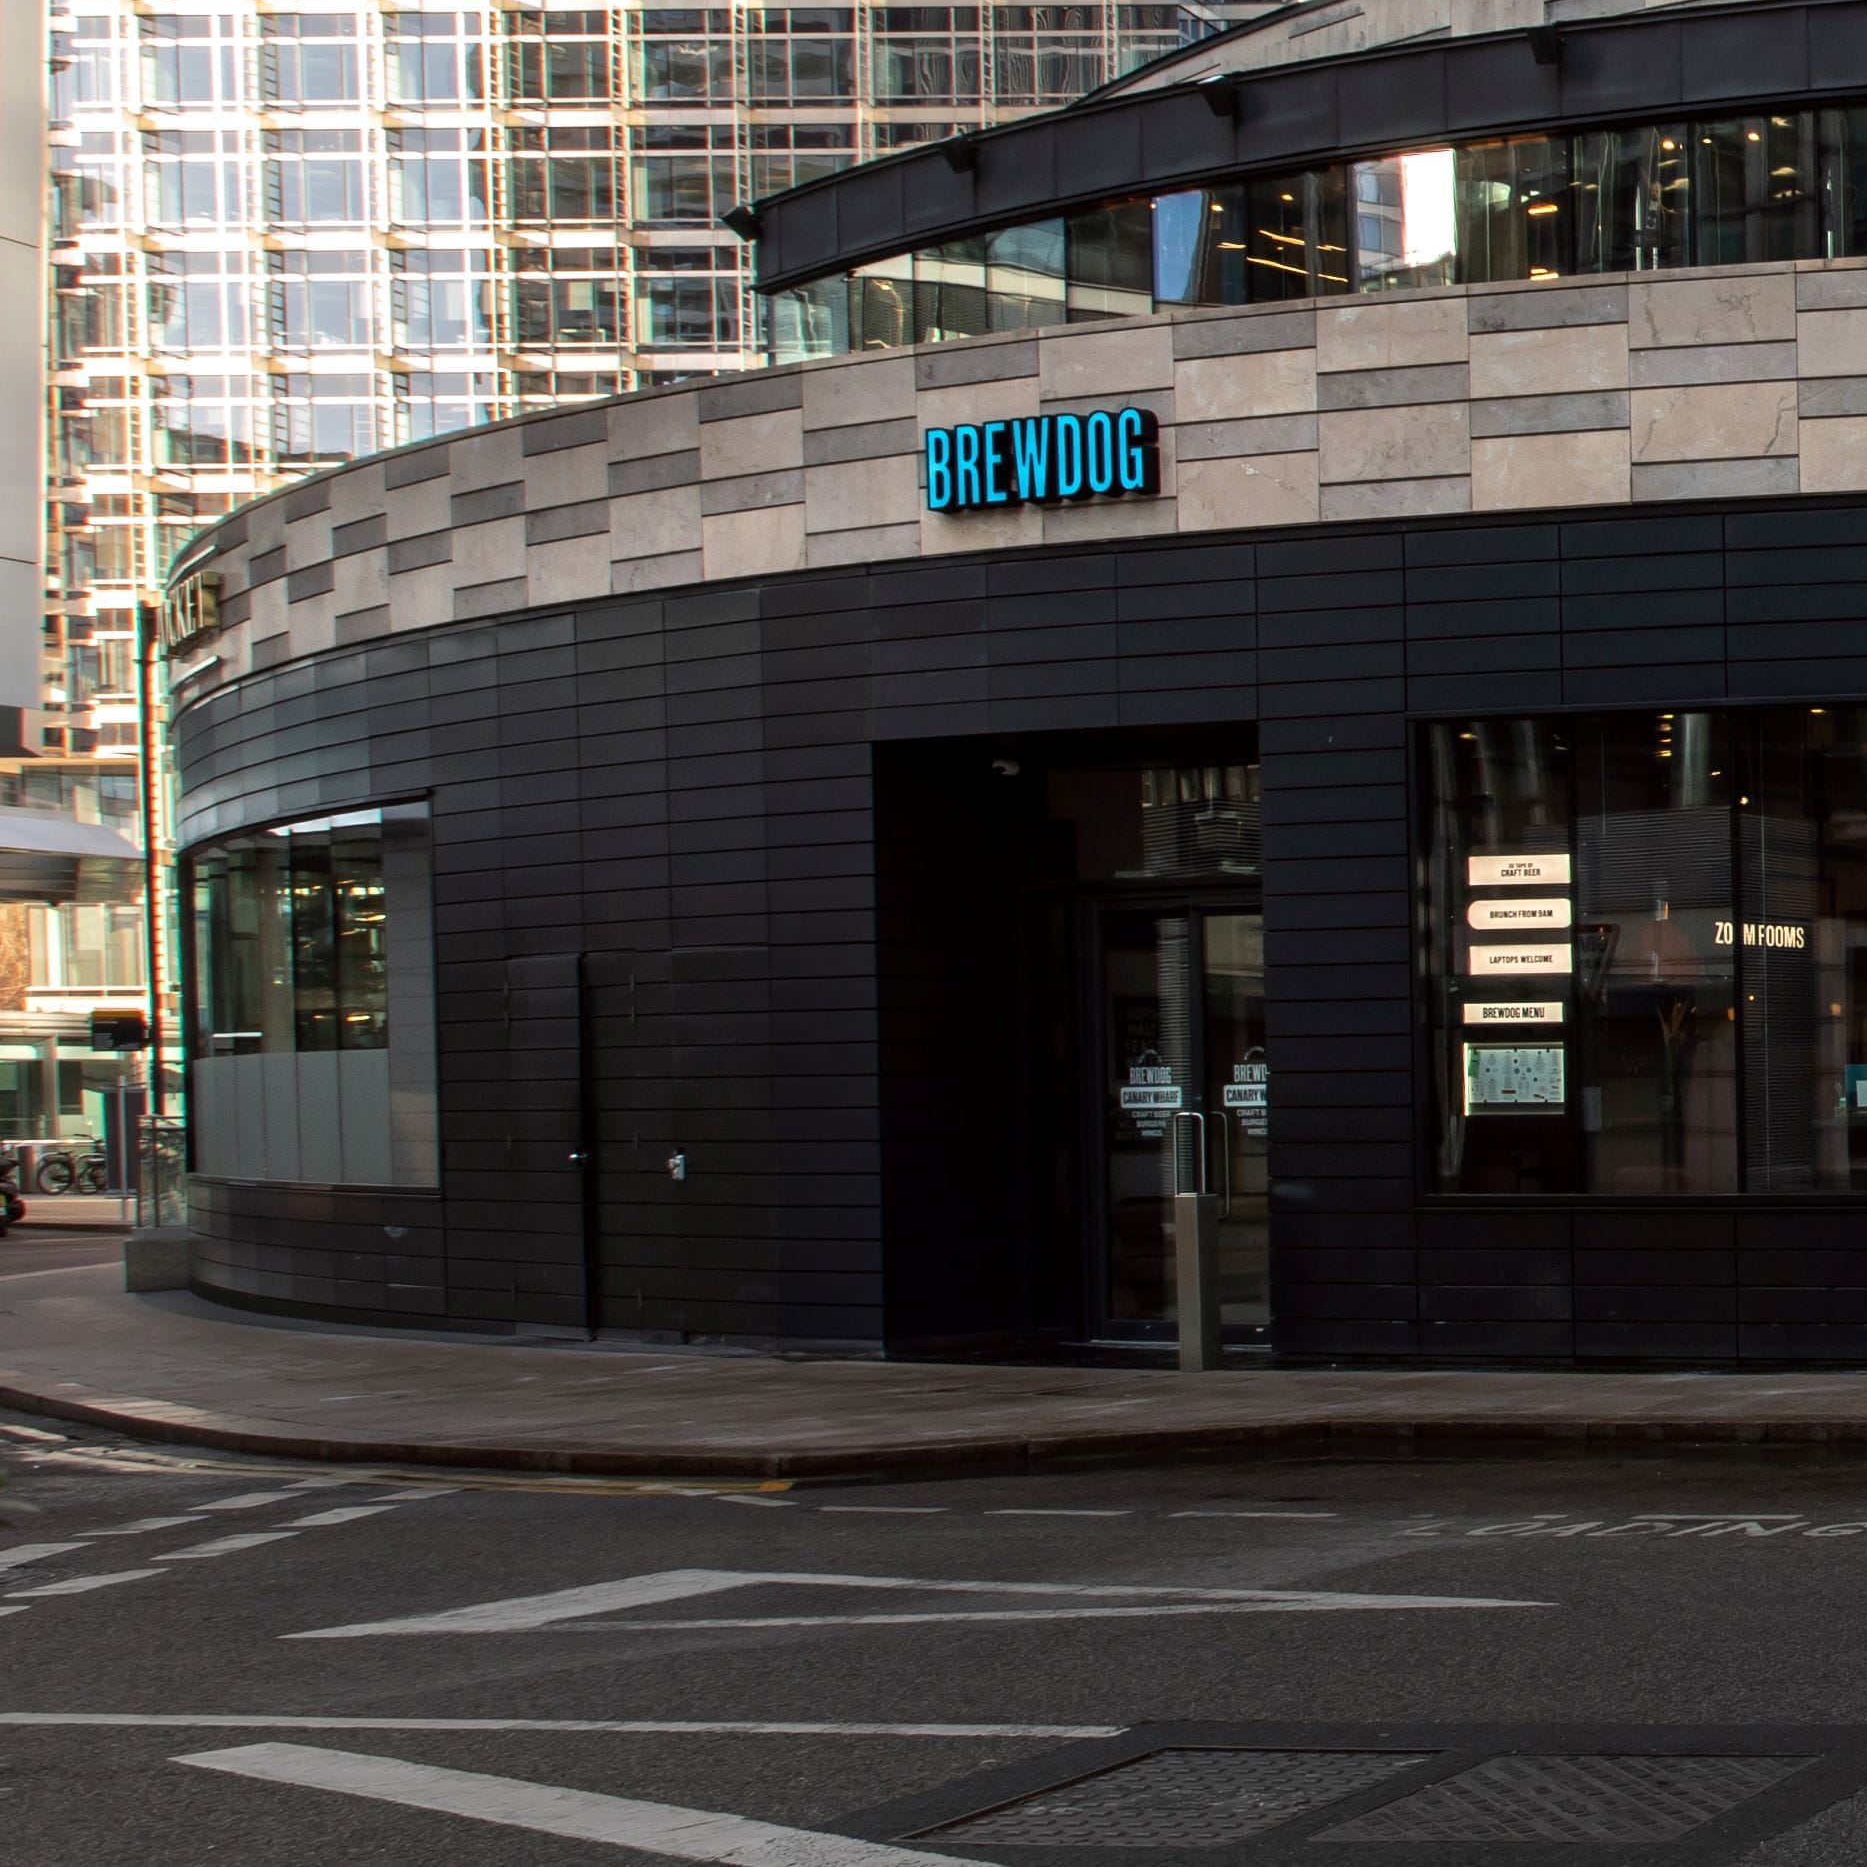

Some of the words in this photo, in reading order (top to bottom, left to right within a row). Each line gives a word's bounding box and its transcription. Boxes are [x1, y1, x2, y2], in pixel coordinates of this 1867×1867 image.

[927, 407, 1146, 510] BREWDOG
[1501, 869, 1522, 877] CRAFT
[1523, 868, 1541, 877] BEER
[1489, 910, 1517, 919] BRUNCH
[1518, 910, 1537, 918] FROM
[1538, 909, 1553, 918] 9AM
[1714, 921, 1756, 945] ZOM
[1489, 956, 1518, 964] LAPTOPS
[1520, 954, 1553, 964] WELCOME
[1482, 1007, 1520, 1019] BREWDOG
[1522, 1007, 1545, 1018] MENU
[1129, 1066, 1172, 1084] BREWDOG
[1122, 1091, 1152, 1104] CANARY
[1153, 1090, 1179, 1103] WHARF
[1226, 1089, 1258, 1102] CANARY
